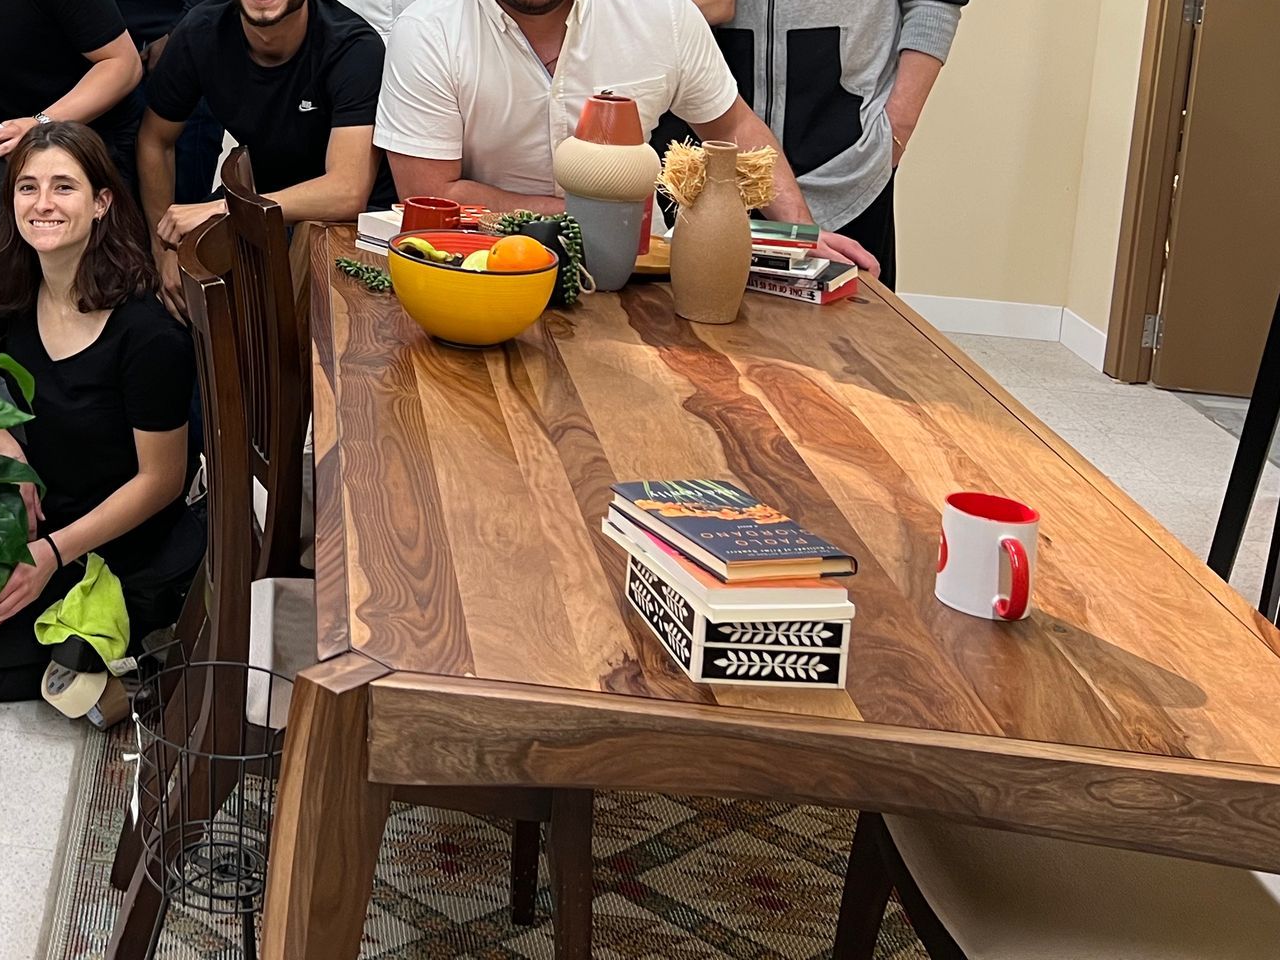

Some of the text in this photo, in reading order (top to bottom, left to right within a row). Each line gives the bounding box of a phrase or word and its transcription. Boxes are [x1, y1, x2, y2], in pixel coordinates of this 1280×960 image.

[766, 283, 778, 292] US
[789, 288, 803, 296] ONE
[700, 529, 815, 539] GIORDANO
[735, 538, 808, 546] PAOLO
